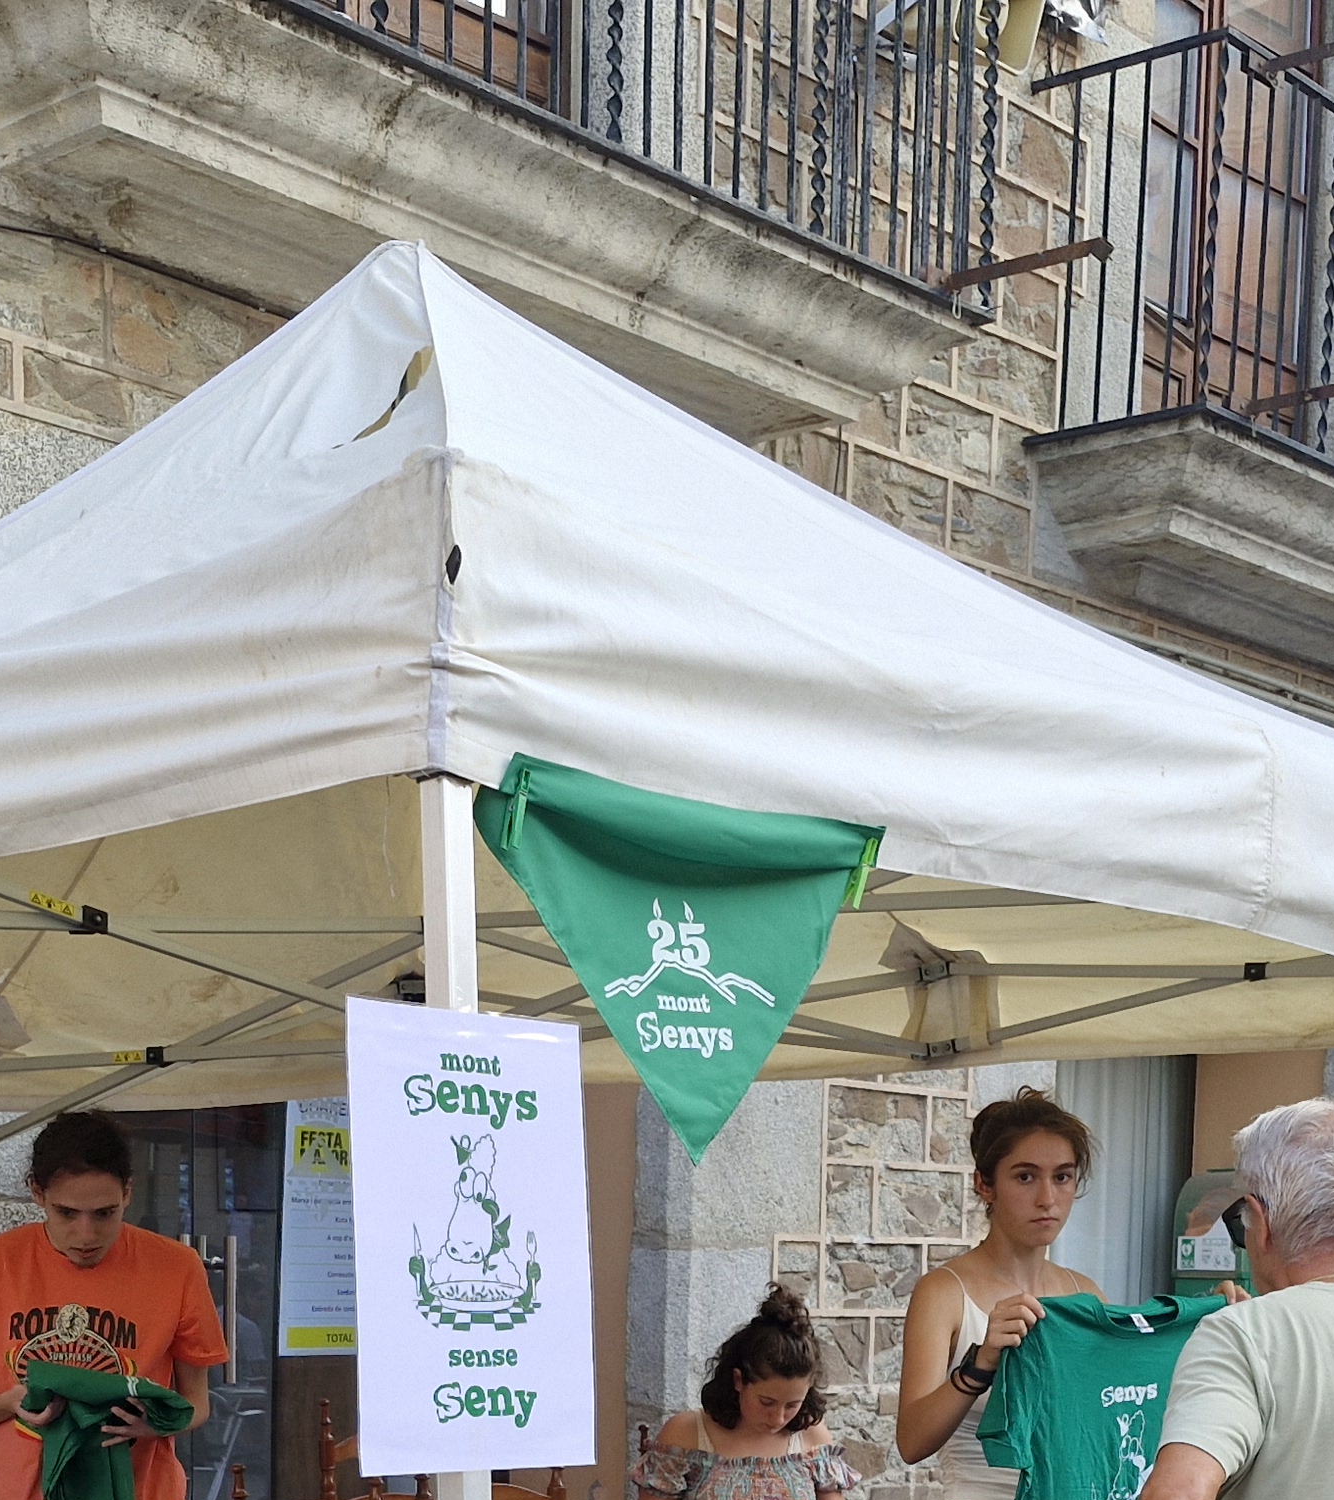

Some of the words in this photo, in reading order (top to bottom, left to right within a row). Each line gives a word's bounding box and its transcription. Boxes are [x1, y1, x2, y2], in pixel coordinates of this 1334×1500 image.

[647, 918, 711, 967] 25
[657, 994, 711, 1013] mont
[636, 1012, 734, 1059] Senys
[440, 1052, 501, 1077] mont
[403, 1074, 539, 1130] Senys
[326, 1333, 353, 1343] TOTAL
[48, 1351, 93, 1363] SUNSPLASH
[448, 1348, 518, 1368] sense
[433, 1381, 538, 1428] Seny
[1101, 1383, 1158, 1408] Senys
